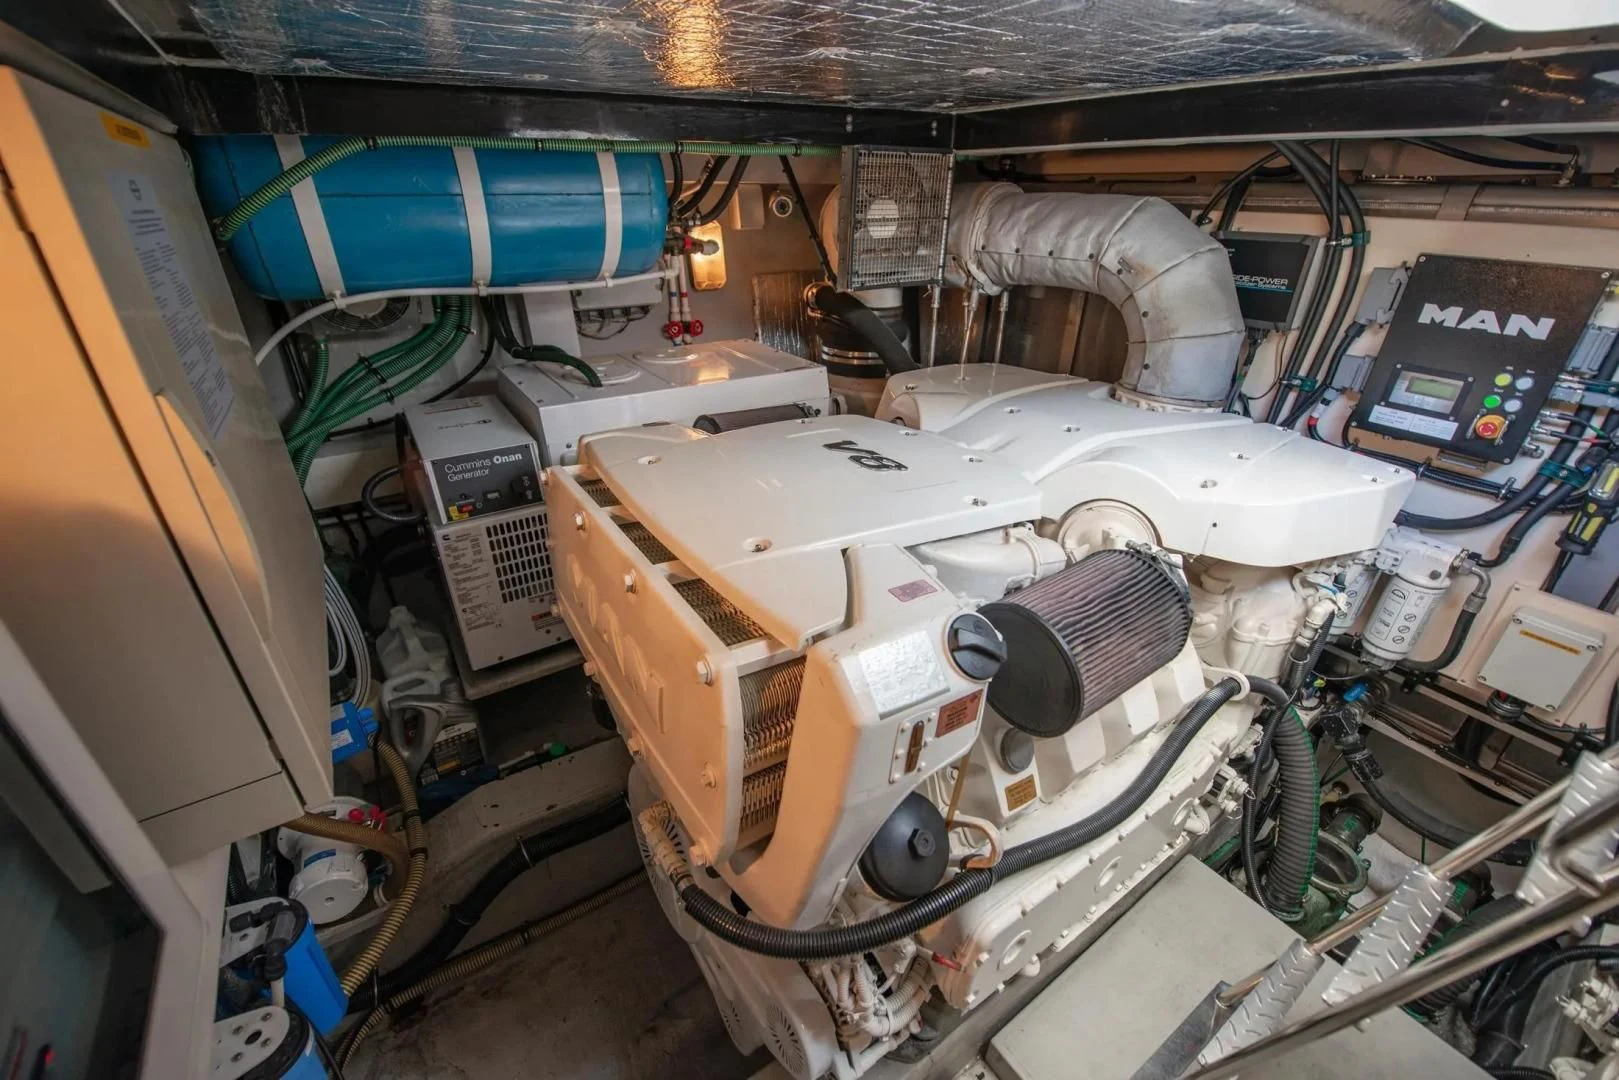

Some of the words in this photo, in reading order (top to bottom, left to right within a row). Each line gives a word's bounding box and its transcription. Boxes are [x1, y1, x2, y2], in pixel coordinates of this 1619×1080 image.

[1417, 302, 1556, 341] MAN
[444, 457, 492, 474] Cummins
[493, 453, 523, 464] Onan
[447, 468, 490, 482] Generator
